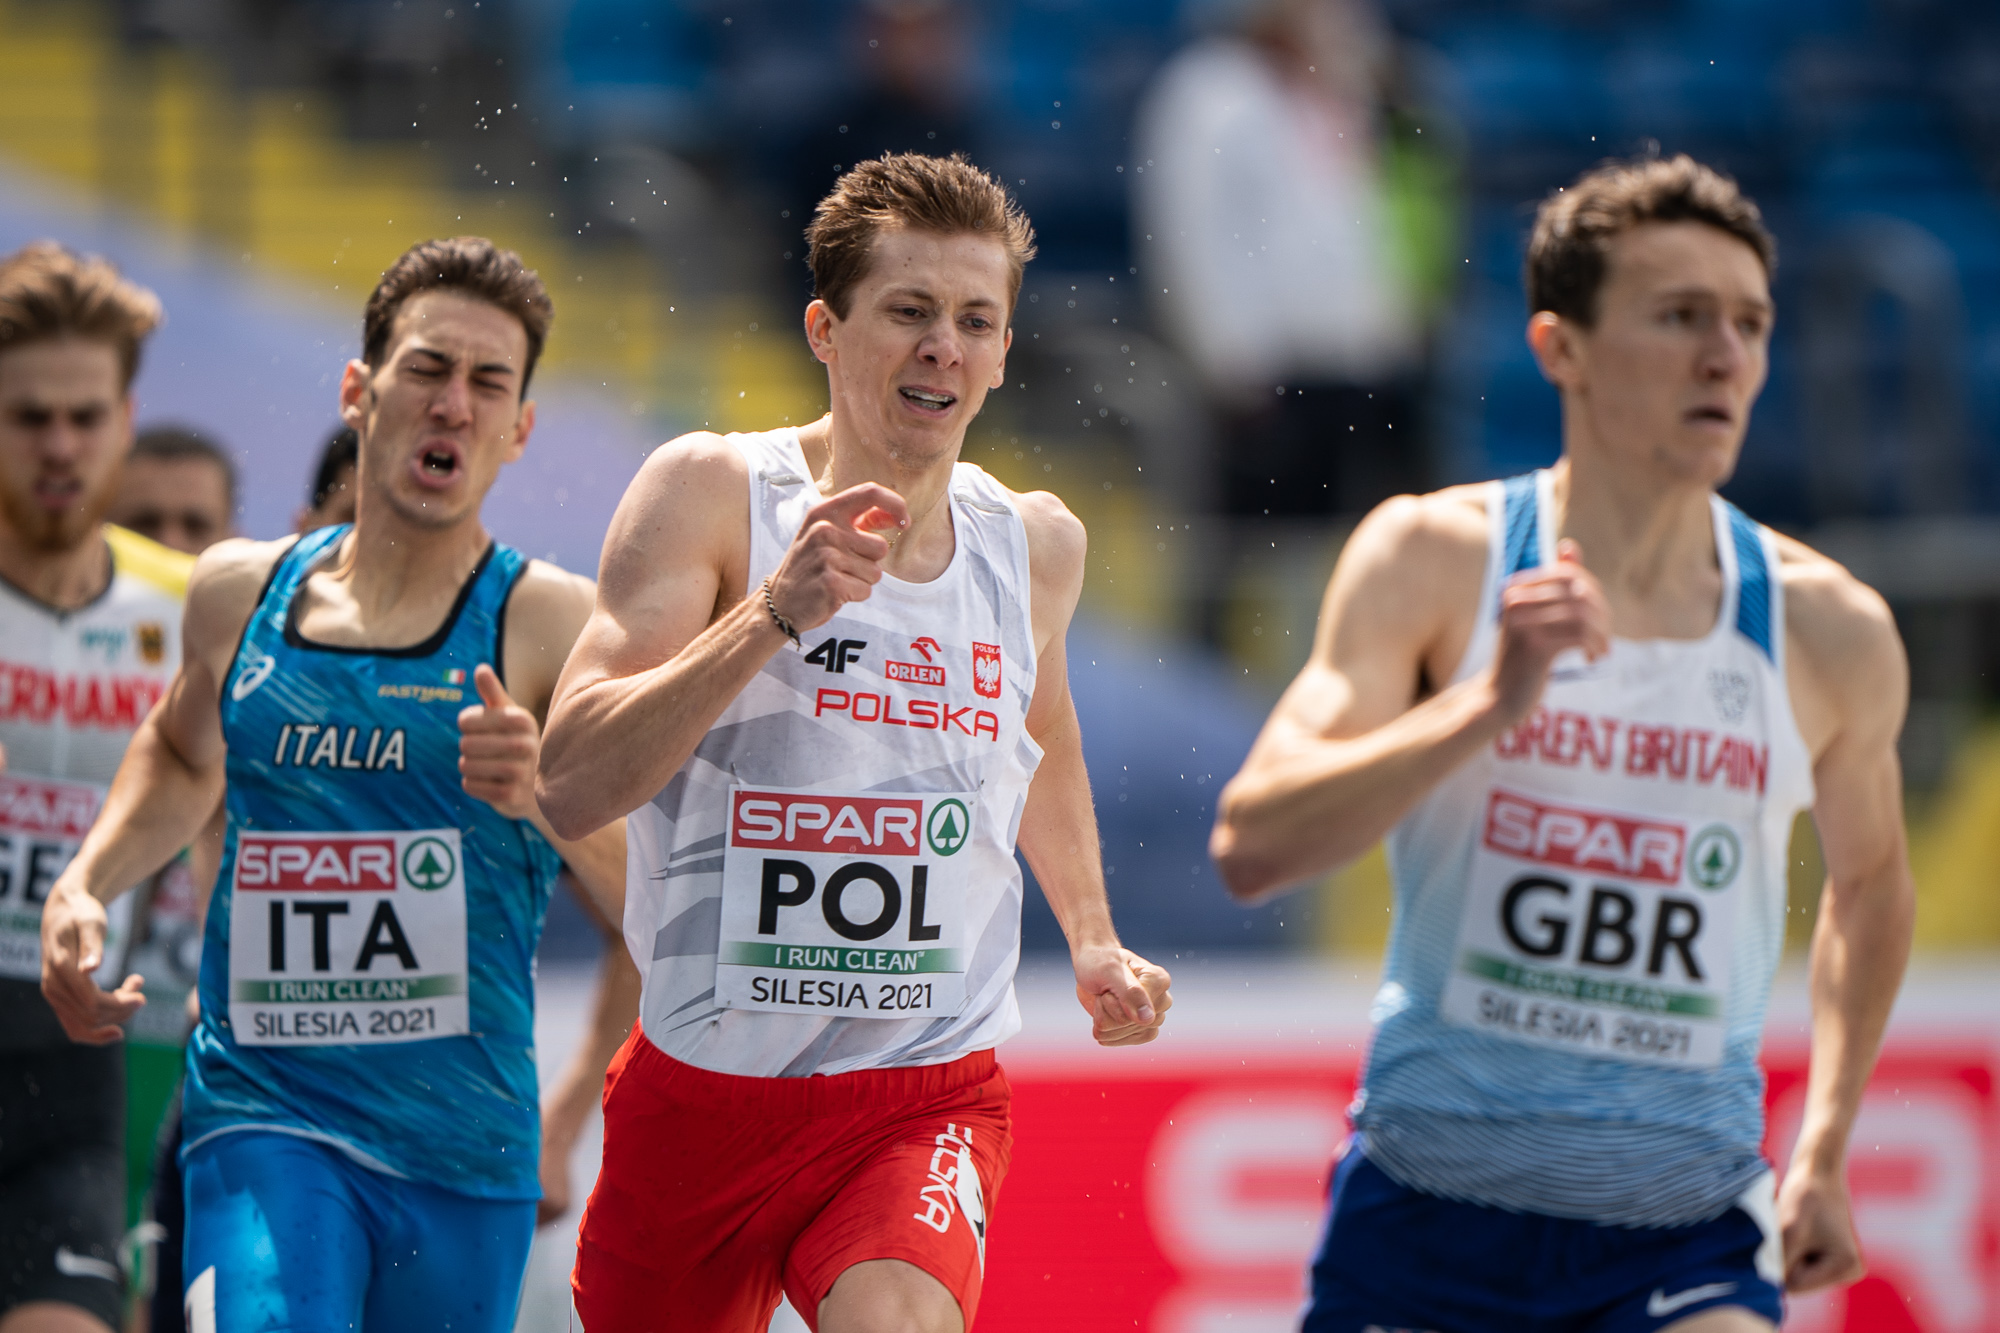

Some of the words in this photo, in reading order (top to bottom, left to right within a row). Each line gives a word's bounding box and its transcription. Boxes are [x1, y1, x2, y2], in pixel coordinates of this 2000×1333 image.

[804, 637, 868, 673] 4F
[974, 644, 1000, 654] POLSKA
[888, 663, 942, 684] ORLEN
[815, 688, 999, 742] POLSKA
[274, 723, 406, 771] ITALIA
[1624, 718, 1769, 797] BRITAIN
[738, 799, 918, 847] SPAR
[1491, 800, 1680, 878] SPAR
[239, 845, 393, 885] SPAR
[758, 858, 941, 942] POL
[269, 900, 420, 972] ITA
[1499, 875, 1706, 981] GBR
[775, 947, 781, 965] I
[788, 947, 838, 967] RUN
[269, 982, 276, 999] I
[281, 981, 330, 999] RUN
[750, 976, 869, 1009] SILESIA
[878, 983, 932, 1010] 2021
[253, 1011, 361, 1038] SILESIA
[368, 1007, 436, 1035] 2021
[1478, 988, 1604, 1044] SILESIA
[1611, 1014, 1692, 1057] 2021
